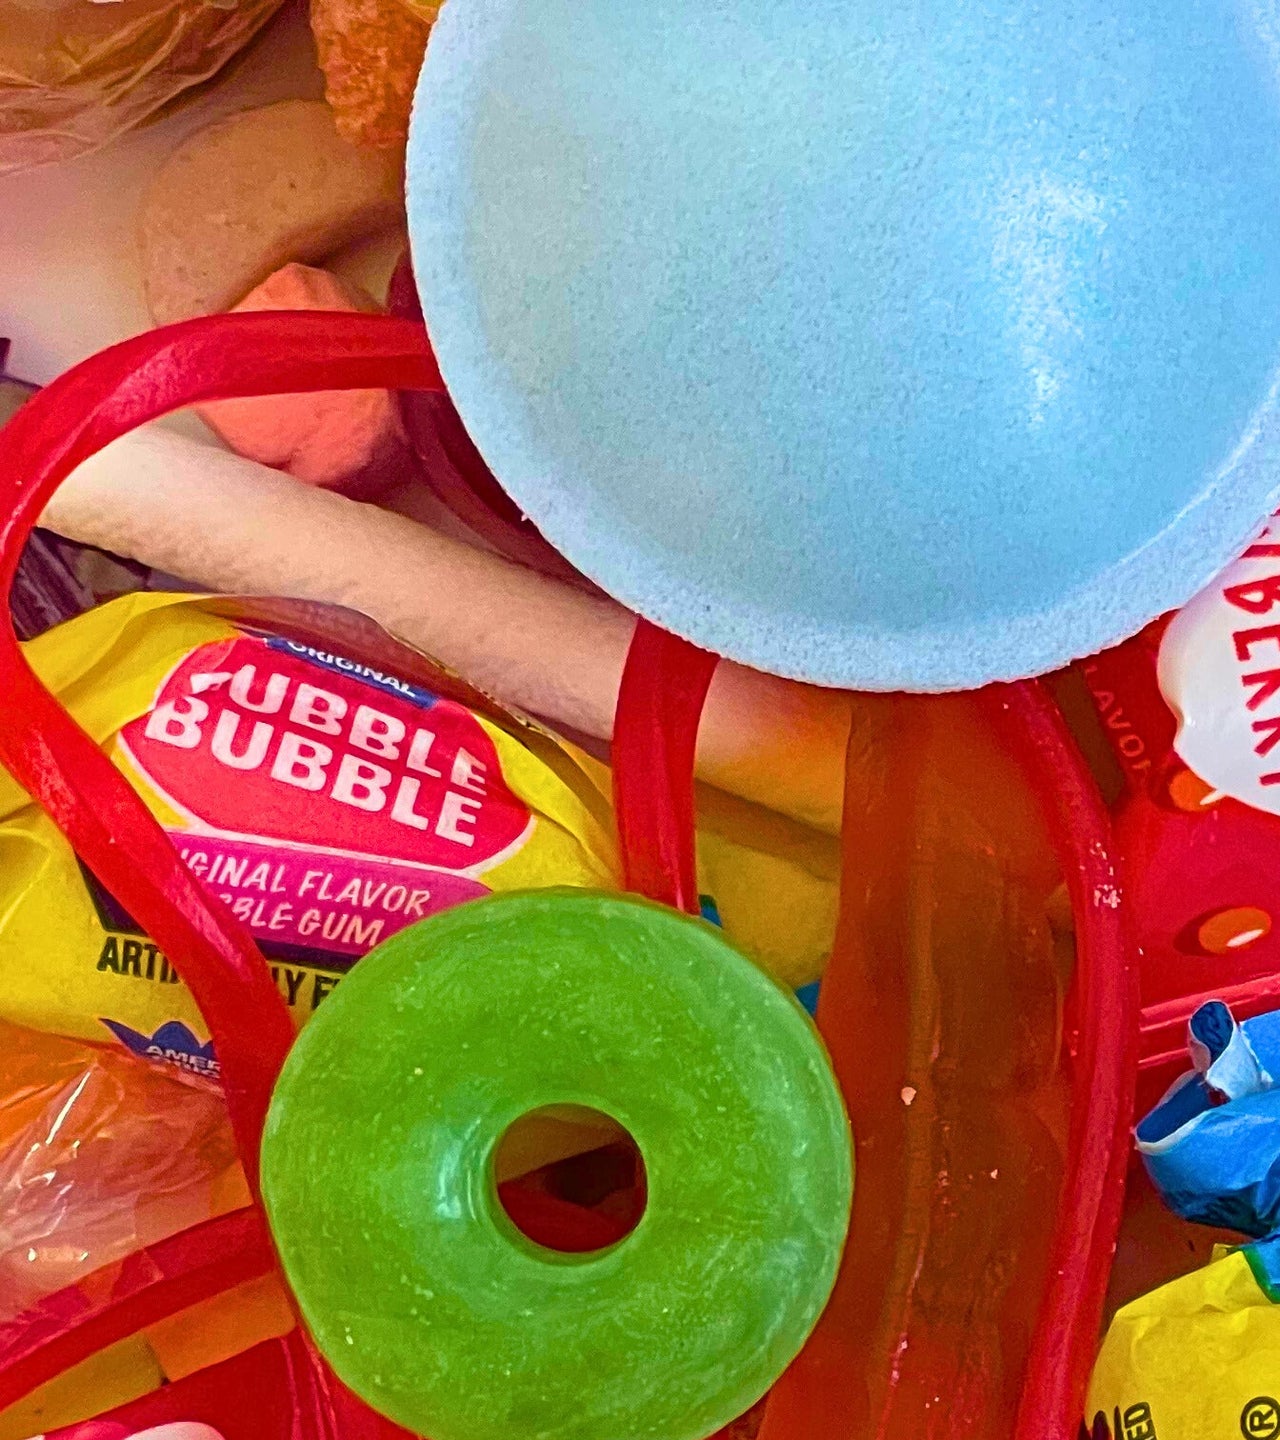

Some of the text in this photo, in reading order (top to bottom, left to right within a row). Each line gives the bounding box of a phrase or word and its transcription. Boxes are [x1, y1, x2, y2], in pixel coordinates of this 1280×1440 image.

[144, 696, 482, 847] BUBBLE
[298, 869, 430, 916] FLAVOR
[298, 908, 386, 949] GUM
